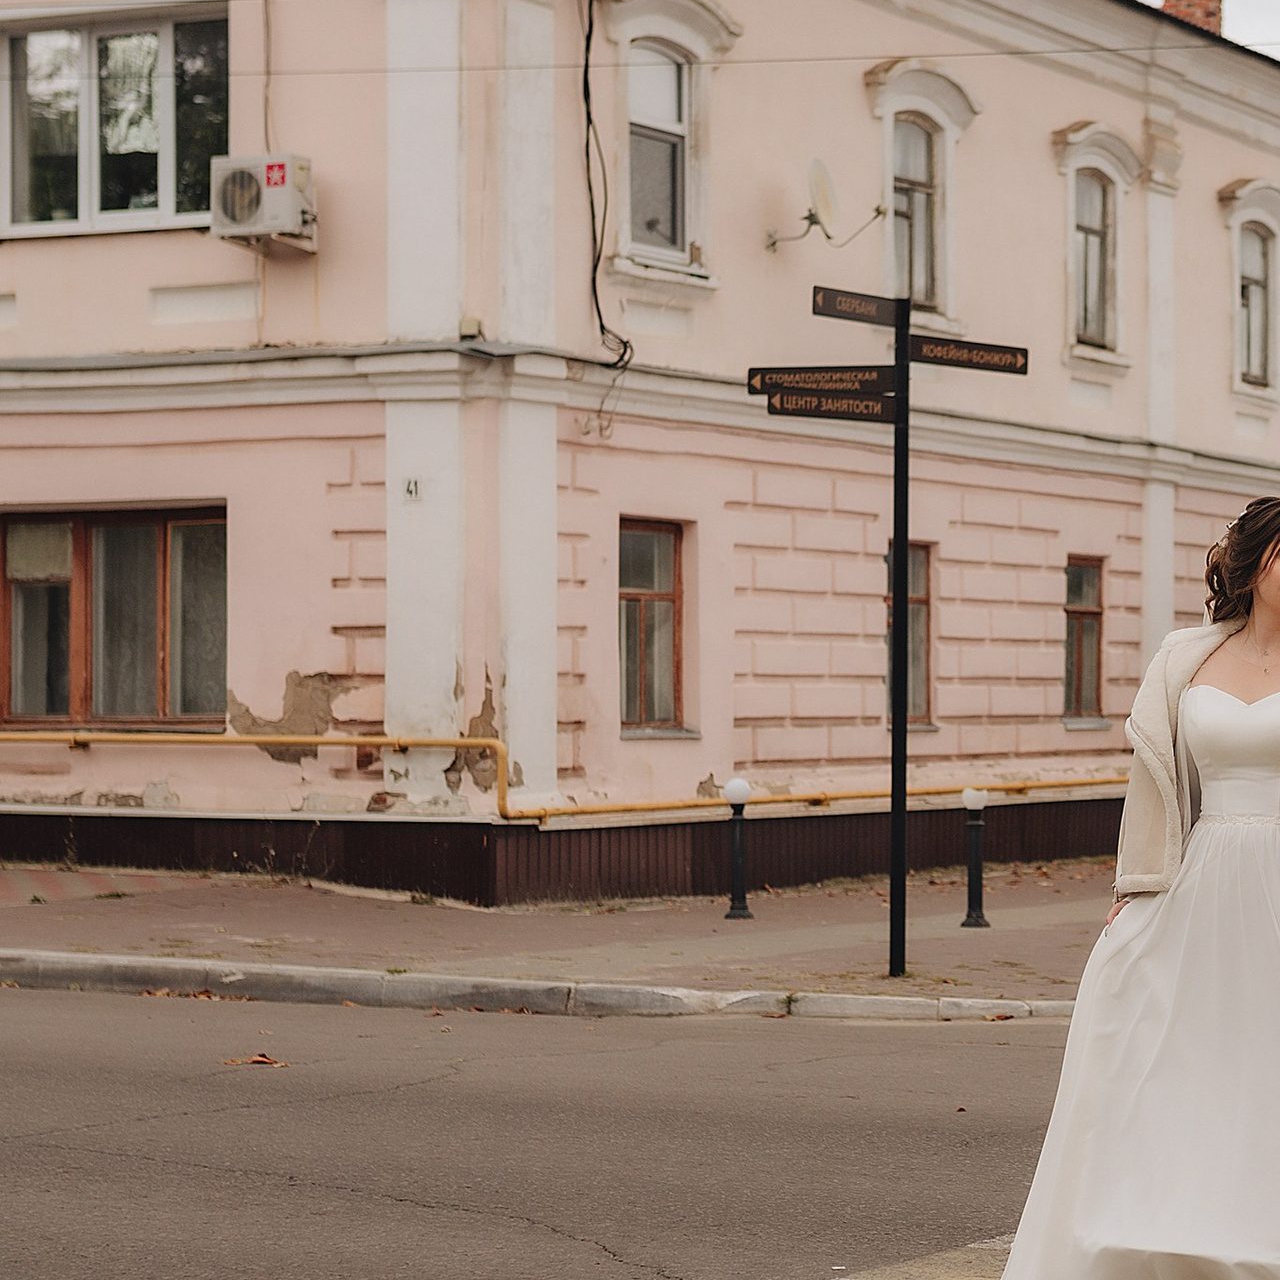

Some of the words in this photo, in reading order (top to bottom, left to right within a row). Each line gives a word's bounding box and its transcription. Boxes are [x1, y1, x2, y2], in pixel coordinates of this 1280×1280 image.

[835, 295, 878, 317] СБЕРБАНК
[922, 343, 967, 361] КОФЕЙНЯ
[765, 372, 878, 384] СТОМАТОЛОГИЧЕСКАЯ
[783, 395, 818, 411] ЦЕНТР
[820, 399, 882, 416] ЗАНЯТОСТИ
[406, 479, 419, 497] 41
